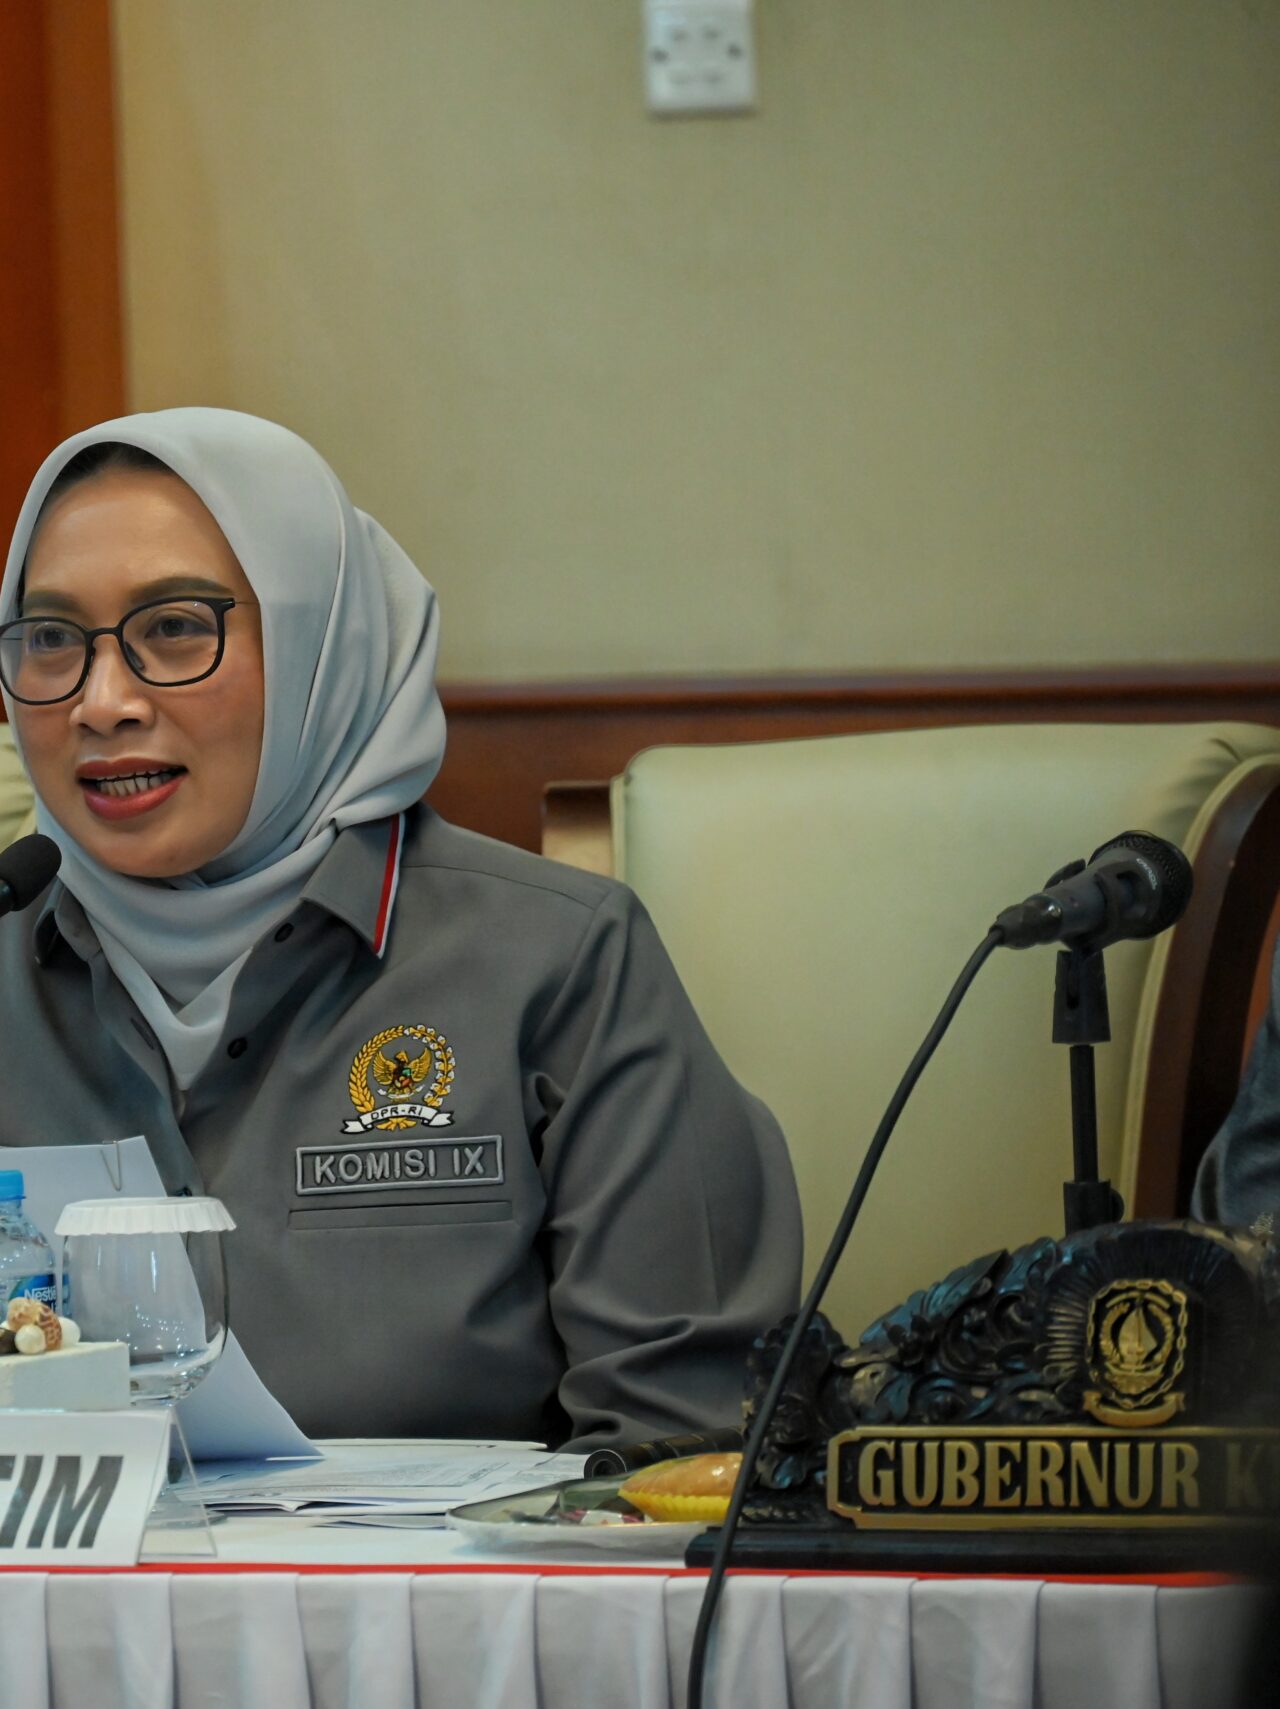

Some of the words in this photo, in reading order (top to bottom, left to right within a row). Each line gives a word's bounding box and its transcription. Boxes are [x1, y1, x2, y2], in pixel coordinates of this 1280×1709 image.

[371, 1106, 424, 1121] DPR-RI
[315, 1149, 437, 1184] KOMISI
[453, 1146, 485, 1176] IX
[858, 1440, 1200, 1508] GUBERNUR
